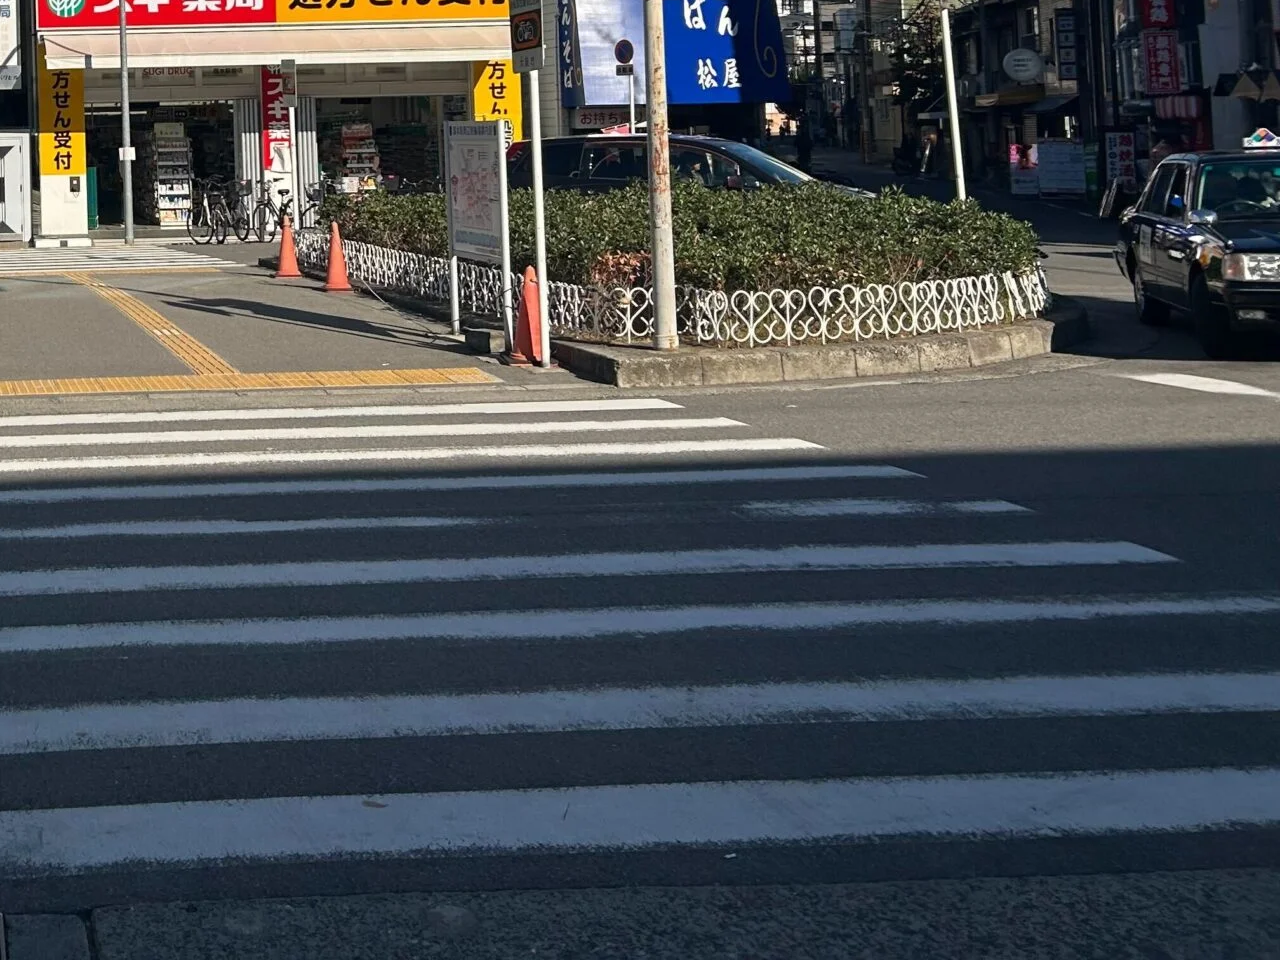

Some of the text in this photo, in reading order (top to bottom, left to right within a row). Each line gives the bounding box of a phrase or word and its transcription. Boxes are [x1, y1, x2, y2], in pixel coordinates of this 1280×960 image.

[143, 67, 193, 76] SUGI DRUG
[697, 57, 742, 90] 松屋
[52, 71, 73, 171] 方せん受付
